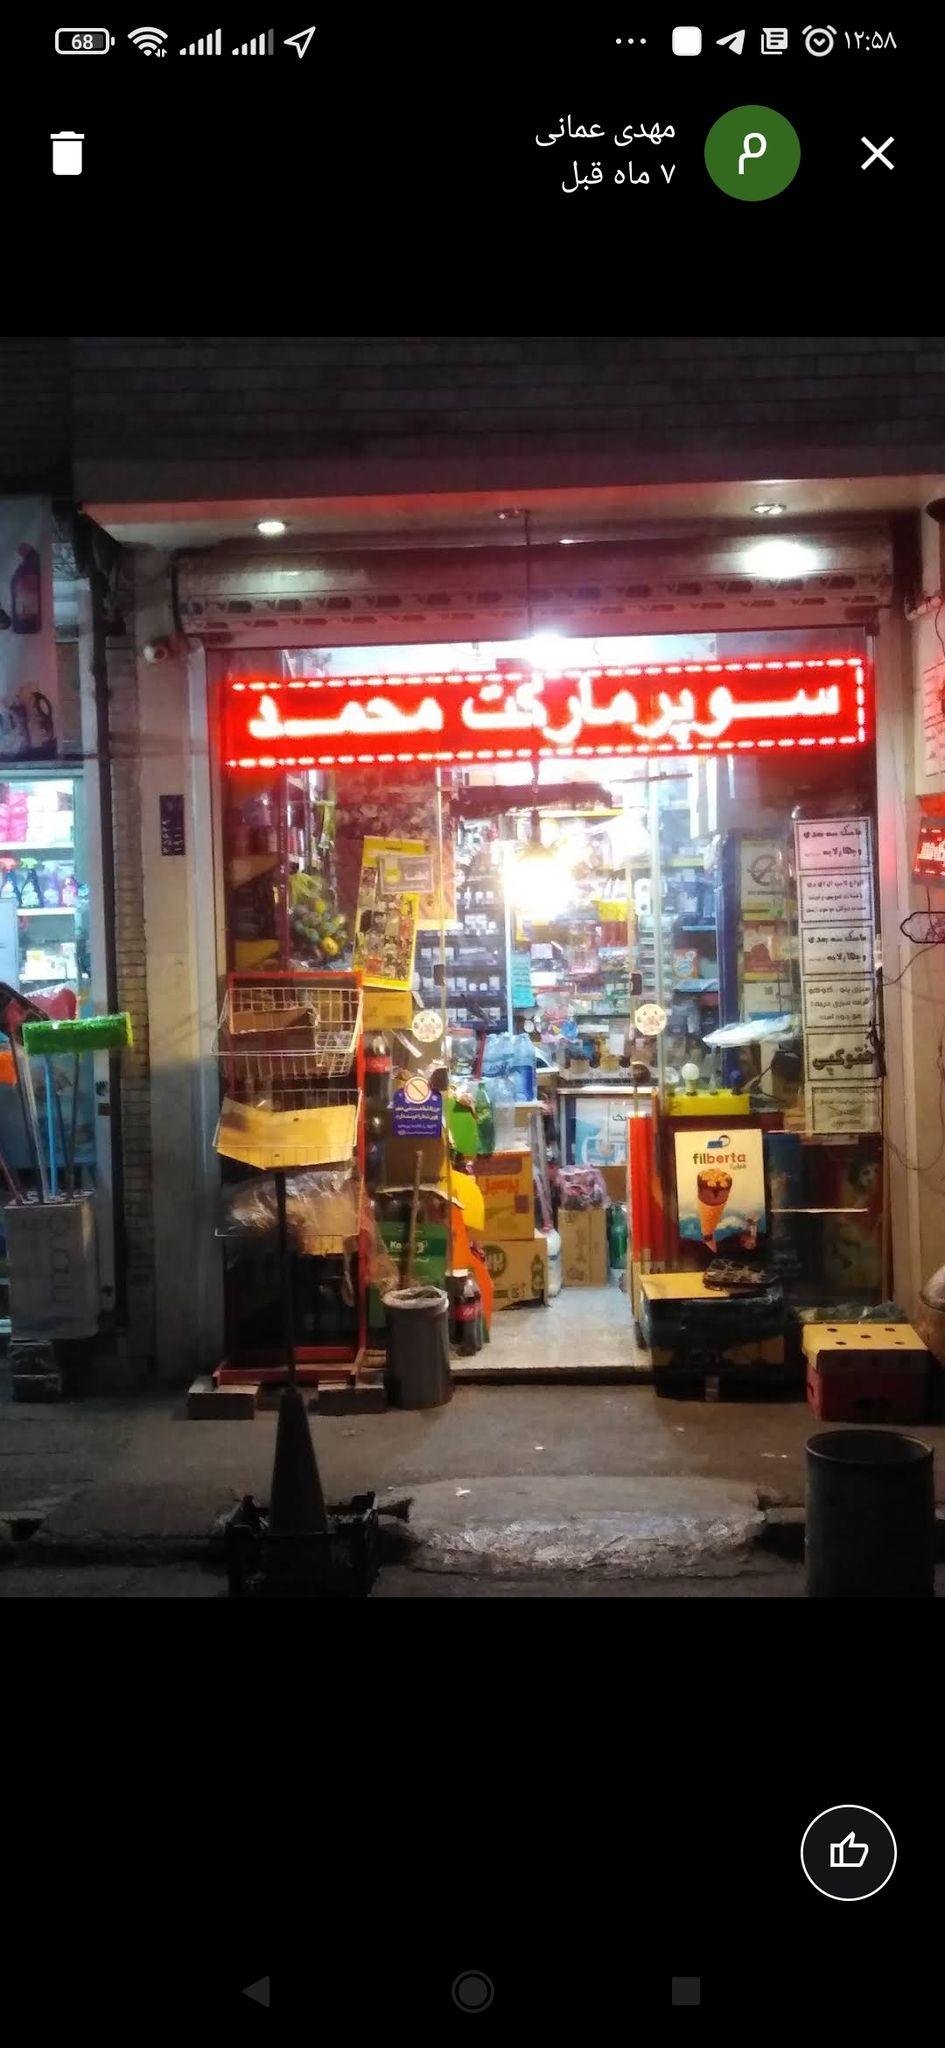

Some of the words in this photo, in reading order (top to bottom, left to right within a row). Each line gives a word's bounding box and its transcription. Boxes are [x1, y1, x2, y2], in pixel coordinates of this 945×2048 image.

[248, 692, 445, 740] محمد
[840, 824, 862, 836] ماسک
[844, 929, 867, 942] ماسک
[812, 1043, 873, 1076] فتوکپی
[692, 1152, 747, 1165] filberta
